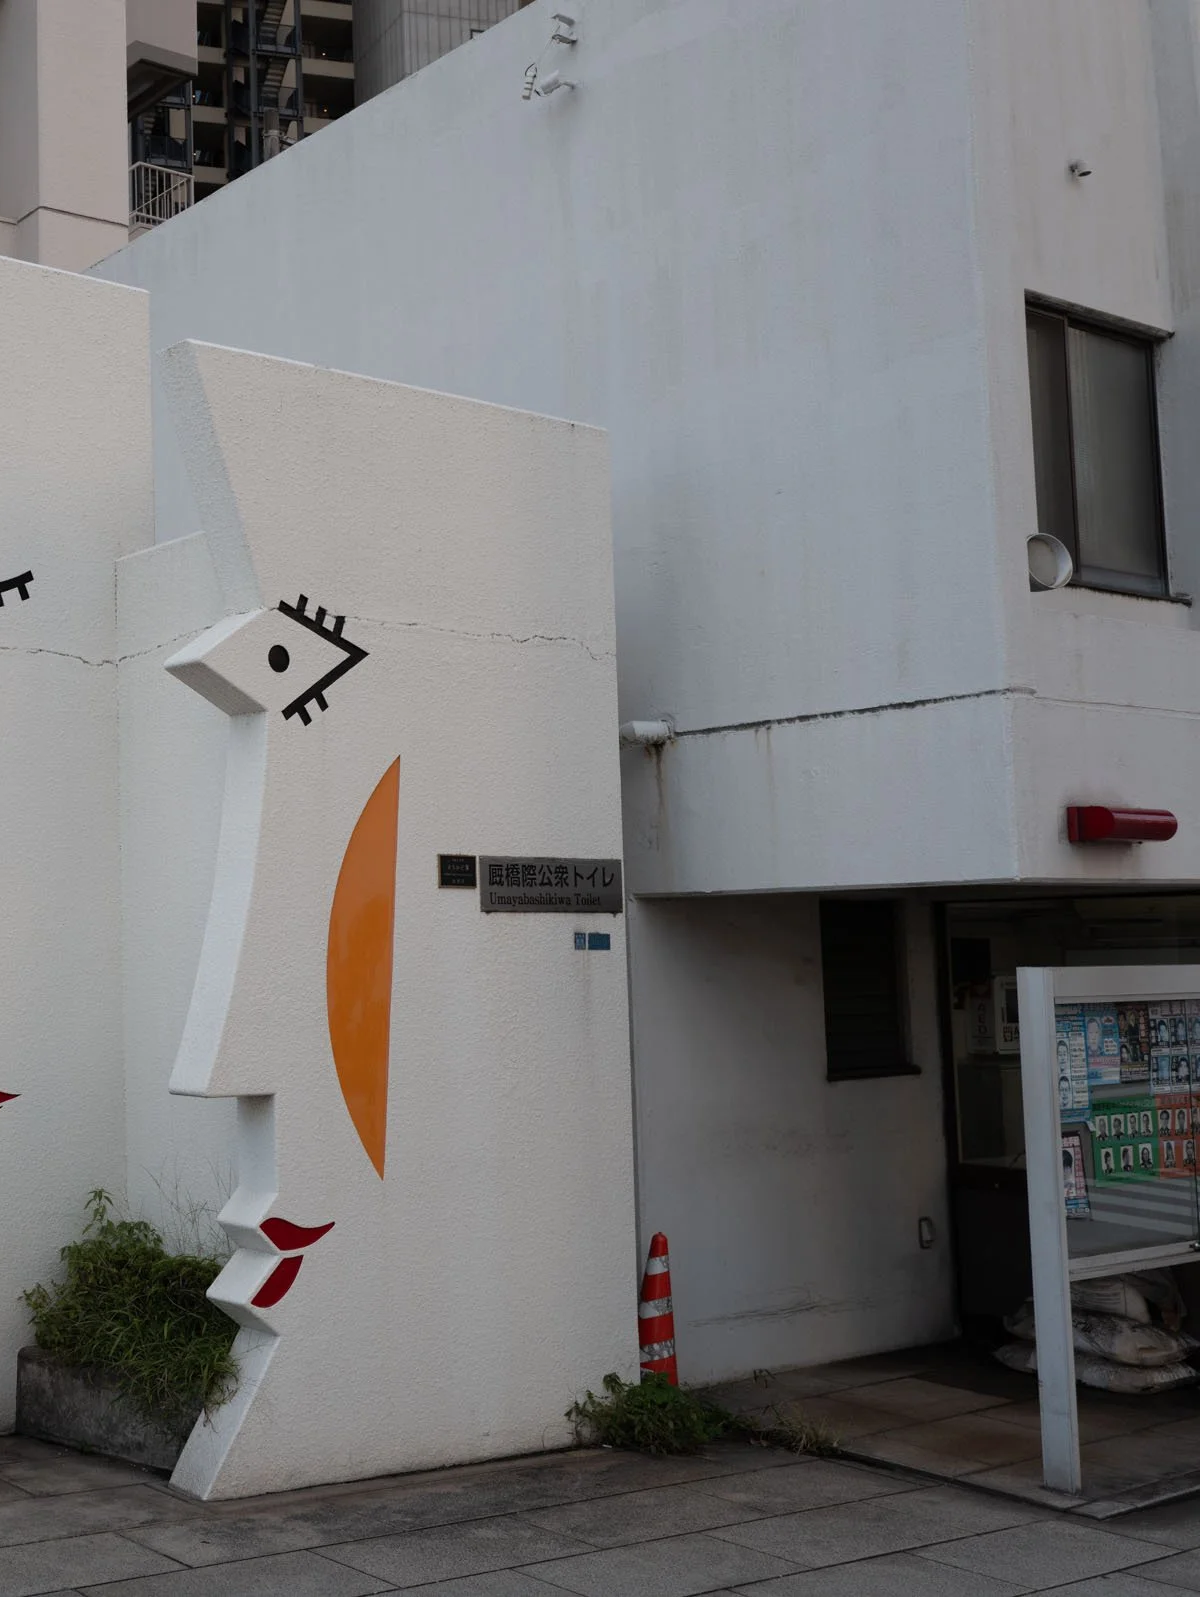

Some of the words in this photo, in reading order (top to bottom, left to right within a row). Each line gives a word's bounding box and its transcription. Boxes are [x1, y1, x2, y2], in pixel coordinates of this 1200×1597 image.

[488, 863, 615, 888] 厩橋際公衆トイレ
[489, 892, 572, 907] Umayabashikiwa
[574, 893, 601, 906] Toilet
